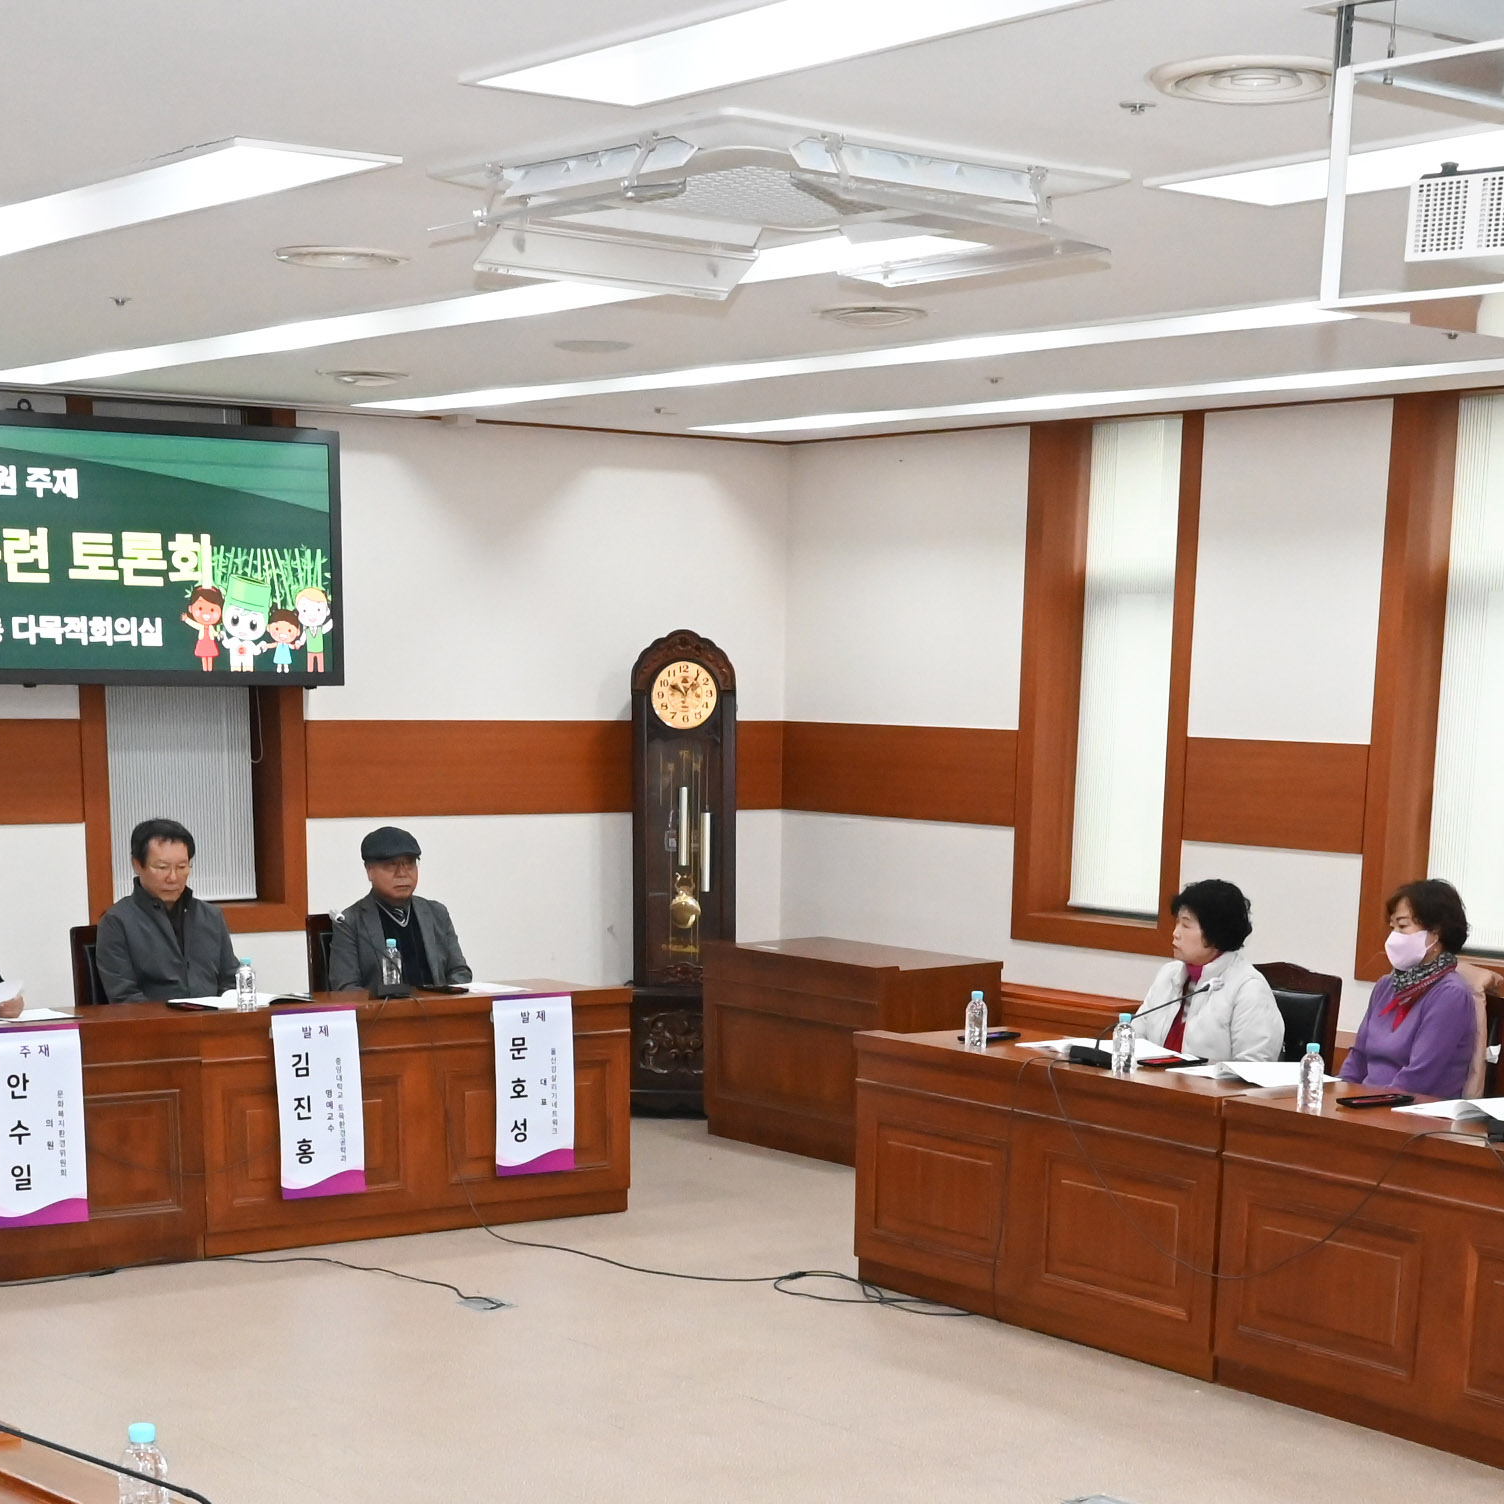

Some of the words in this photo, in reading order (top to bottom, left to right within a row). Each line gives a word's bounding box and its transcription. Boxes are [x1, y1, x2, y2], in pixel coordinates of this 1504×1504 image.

[25, 467, 79, 500] 주재
[68, 531, 213, 590] 토론회
[11, 614, 164, 647] 다목적회의실
[667, 669, 676, 678] 11
[679, 664, 689, 673] 12
[659, 679, 669, 688] 10
[702, 677, 710, 686] 2
[657, 691, 665, 699] 9
[705, 689, 713, 698] 3
[660, 702, 669, 711] 8
[701, 701, 709, 709] 4
[669, 711, 677, 720] 7
[682, 714, 690, 723] 6
[520, 1010, 546, 1024] 발제
[301, 1024, 330, 1039] 발제
[19, 1044, 50, 1059] 주재
[509, 1037, 528, 1143] 문호성
[291, 1052, 315, 1165] 김진홍
[325, 1089, 335, 1133] 명예교수
[7, 1072, 32, 1191] 안수일
